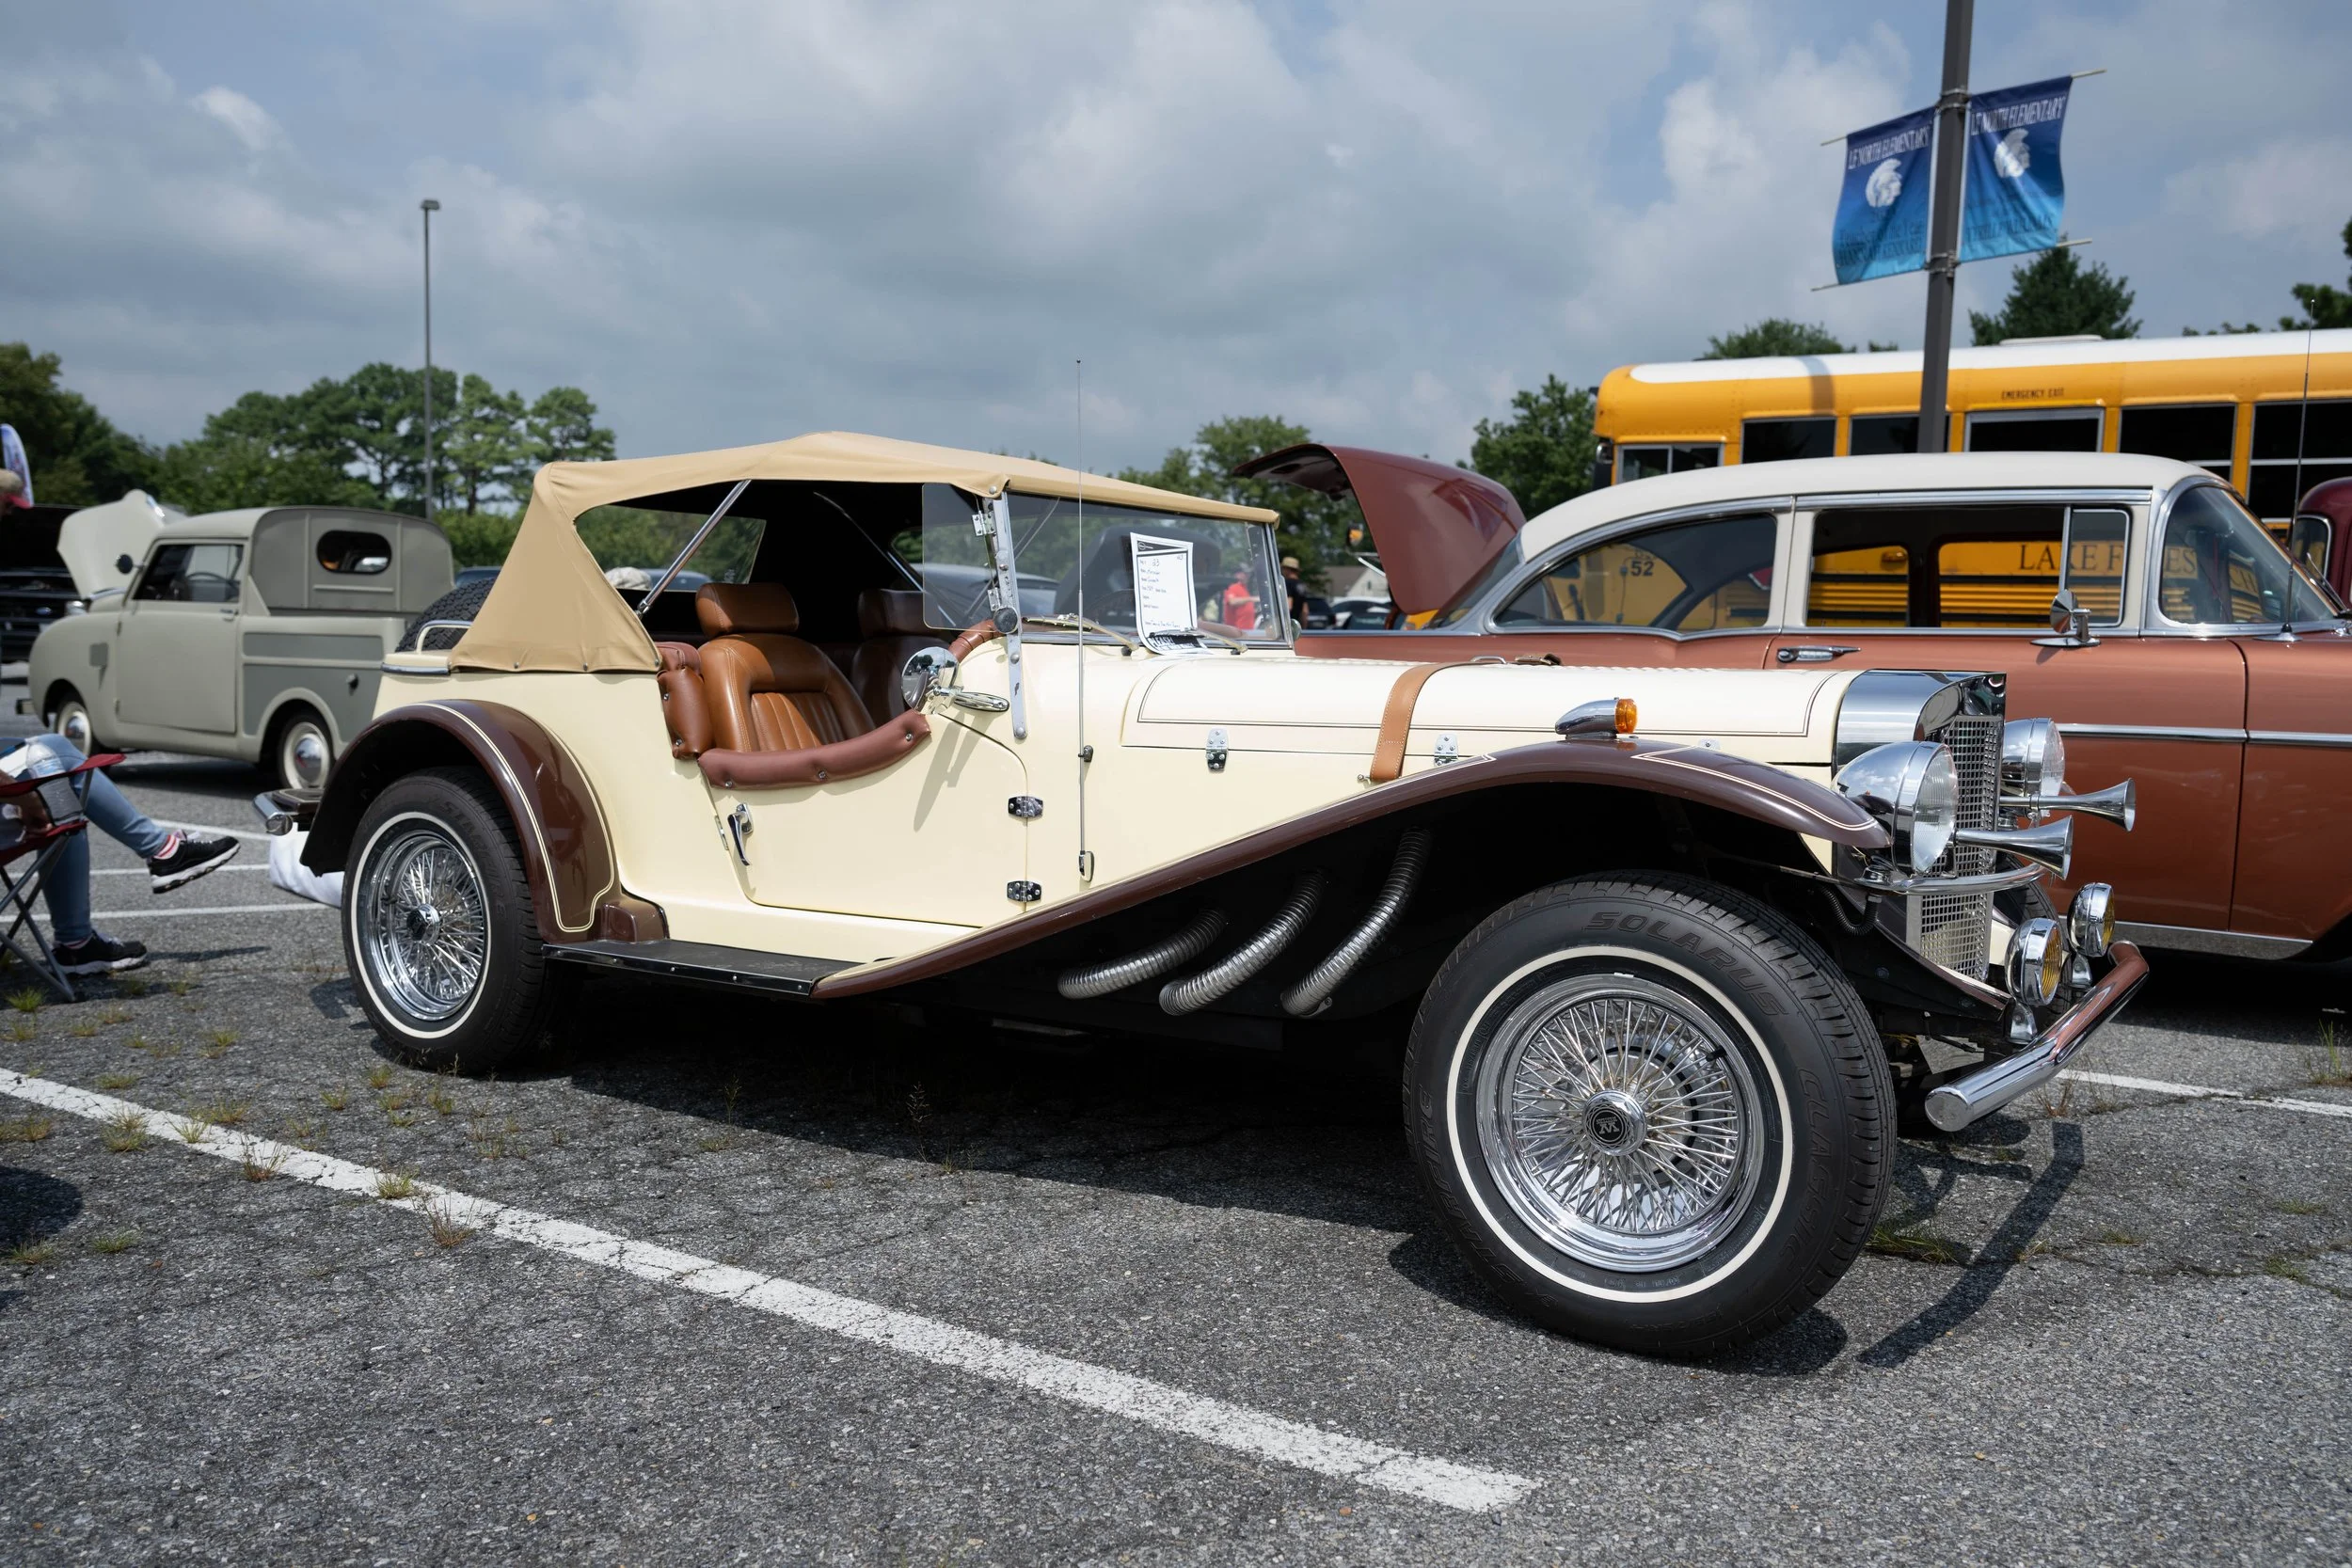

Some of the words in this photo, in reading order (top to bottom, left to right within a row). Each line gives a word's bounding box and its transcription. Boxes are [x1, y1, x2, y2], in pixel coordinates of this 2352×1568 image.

[1980, 107, 2010, 134] NORTH
[2009, 97, 2066, 128] ELEMENTARY
[1858, 141, 1882, 166] NORTH
[1882, 125, 1930, 159] ELEMENTARY
[2001, 389, 2044, 400] EMERGENCY
[2048, 387, 2065, 398] EXIT
[1630, 561, 1654, 577] 52
[1582, 911, 1788, 1016] SOLARUS
[1419, 1084, 1526, 1284] STARFIRE
[1780, 1069, 1832, 1263] CLASSIC
